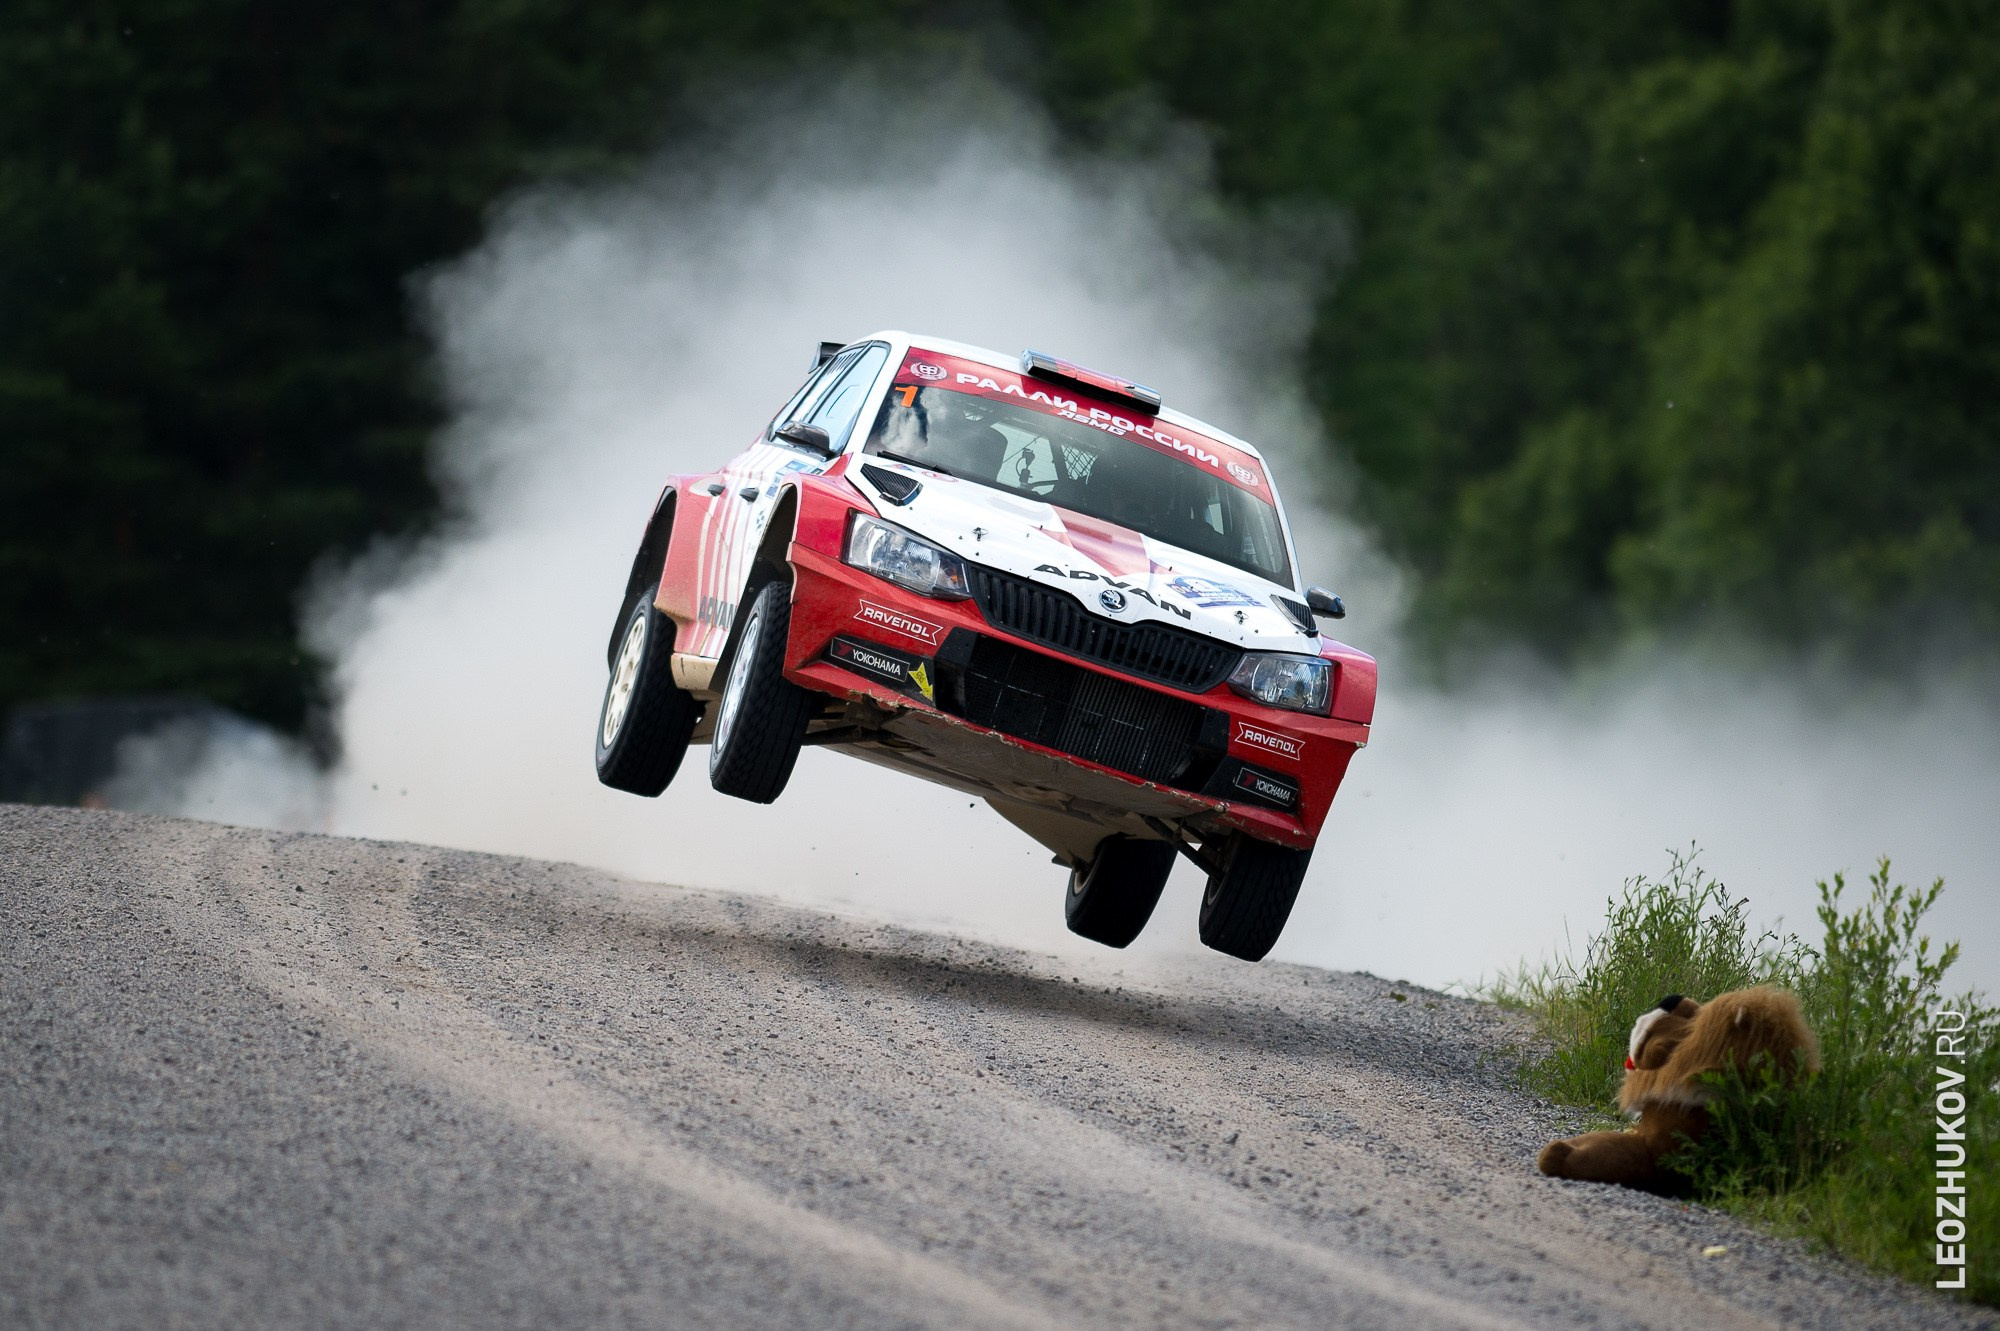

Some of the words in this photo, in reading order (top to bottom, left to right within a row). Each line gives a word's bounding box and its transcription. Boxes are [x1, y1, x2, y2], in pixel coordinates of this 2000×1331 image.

[895, 385, 919, 408] 1
[956, 372, 1078, 413] РАЛЛИ
[1089, 407, 1219, 468] РОССИИ
[1033, 563, 1192, 621] ADVAN
[863, 606, 930, 638] RAVENOL
[852, 648, 901, 676] YOKOHAMA
[1244, 729, 1297, 754] RAVENOL
[1255, 778, 1291, 801] YOKOHAMA
